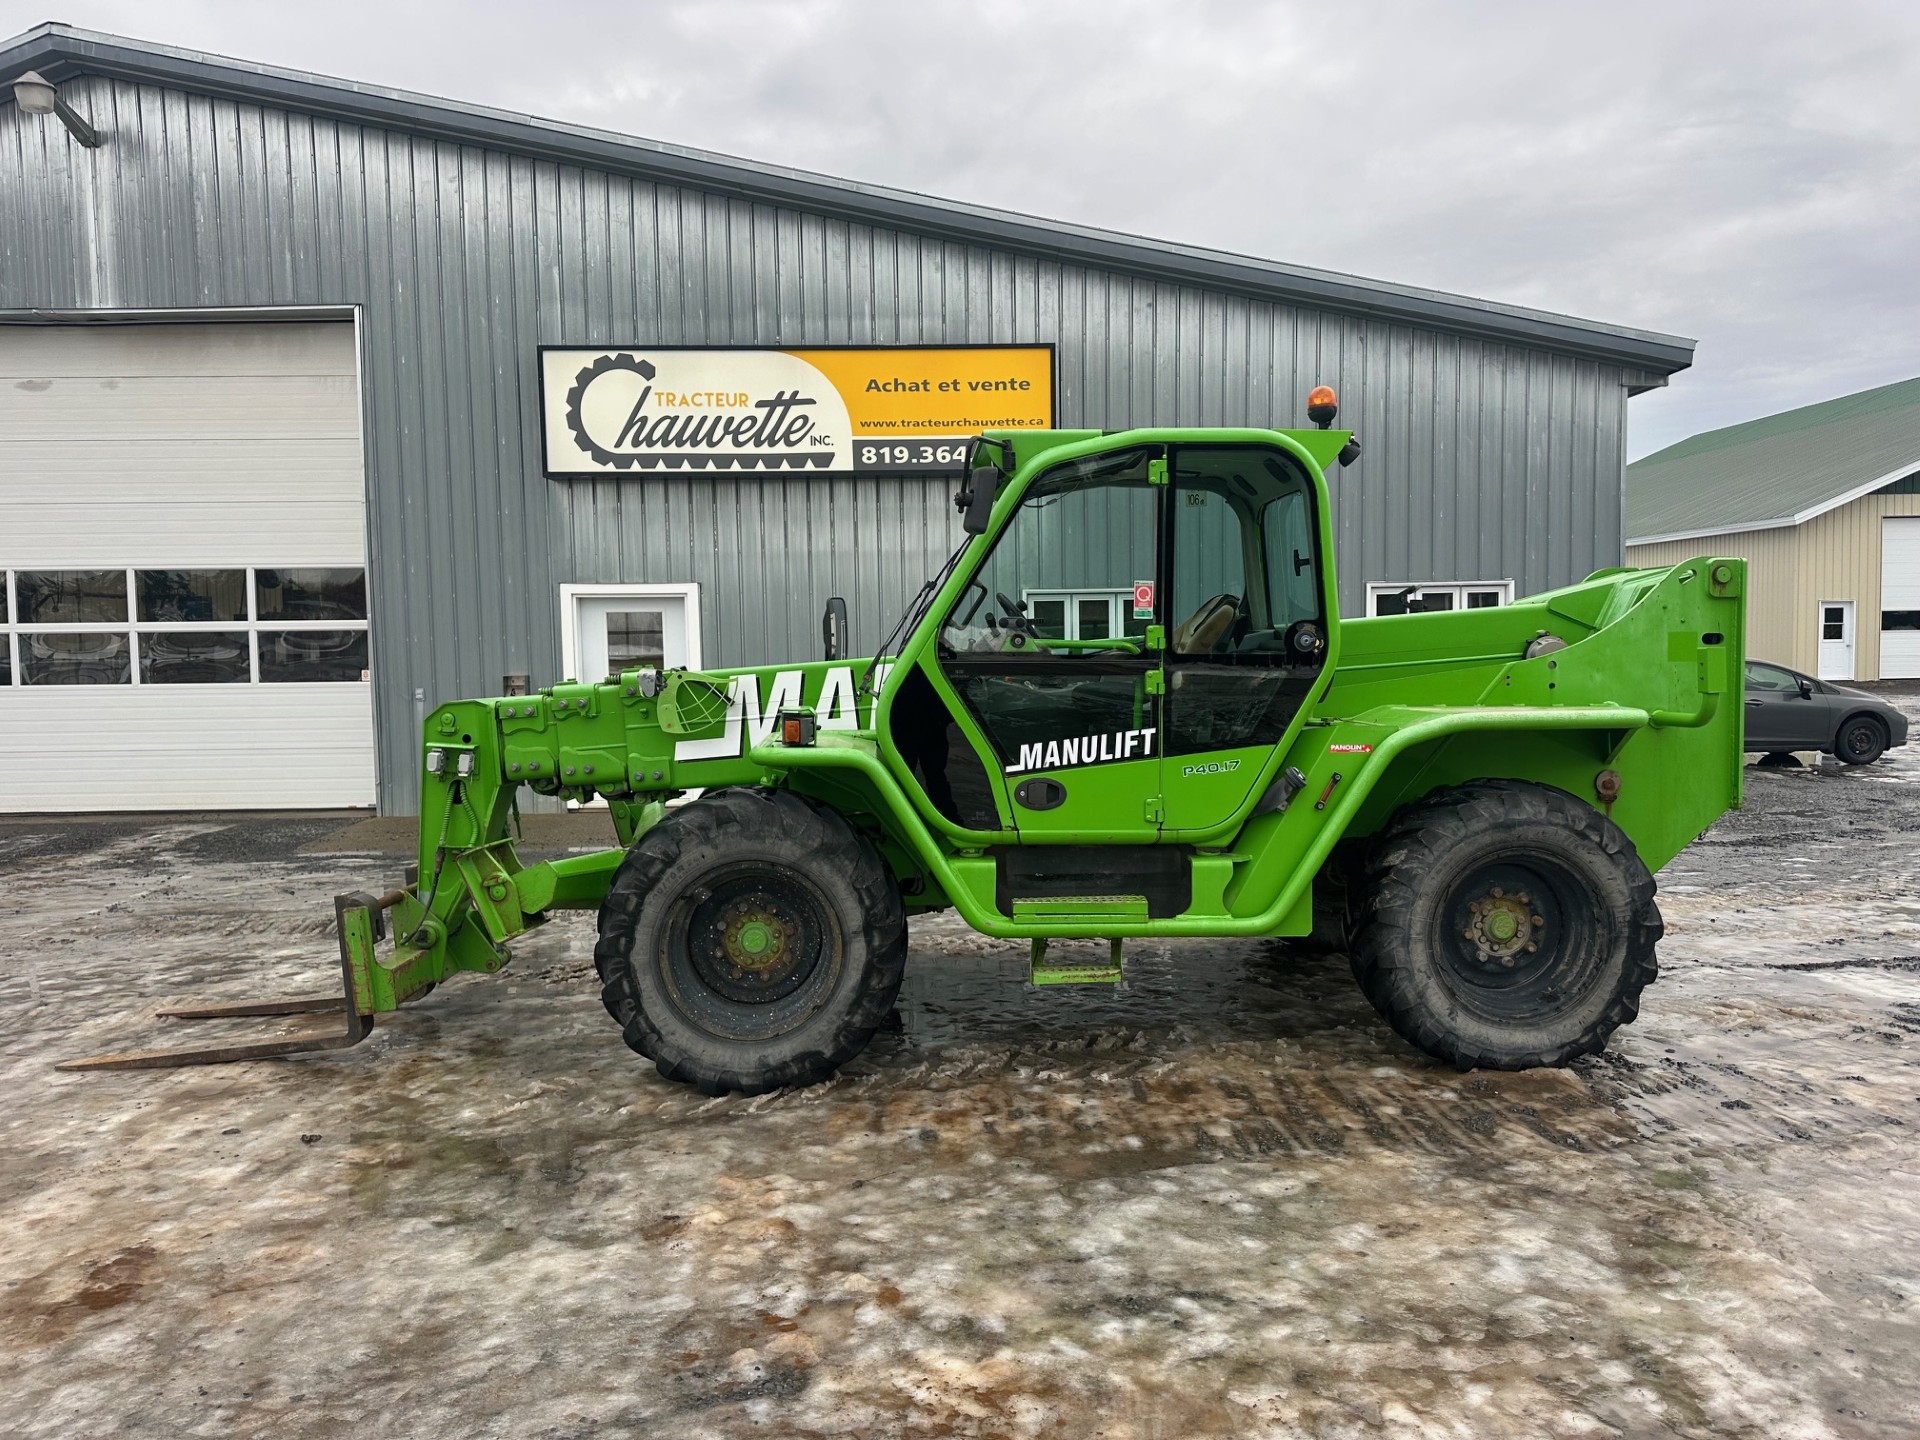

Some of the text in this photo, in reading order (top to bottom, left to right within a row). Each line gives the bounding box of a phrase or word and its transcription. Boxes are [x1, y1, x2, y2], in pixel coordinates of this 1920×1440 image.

[865, 378, 1031, 393] Achat et vente
[655, 392, 749, 408] TRACTEUR
[566, 353, 834, 469] Chauvette INC.
[860, 417, 1044, 428] www.tracteurchauvette.ca
[1005, 728, 1157, 773] MANULIFT
[1183, 759, 1241, 777] P40.17
